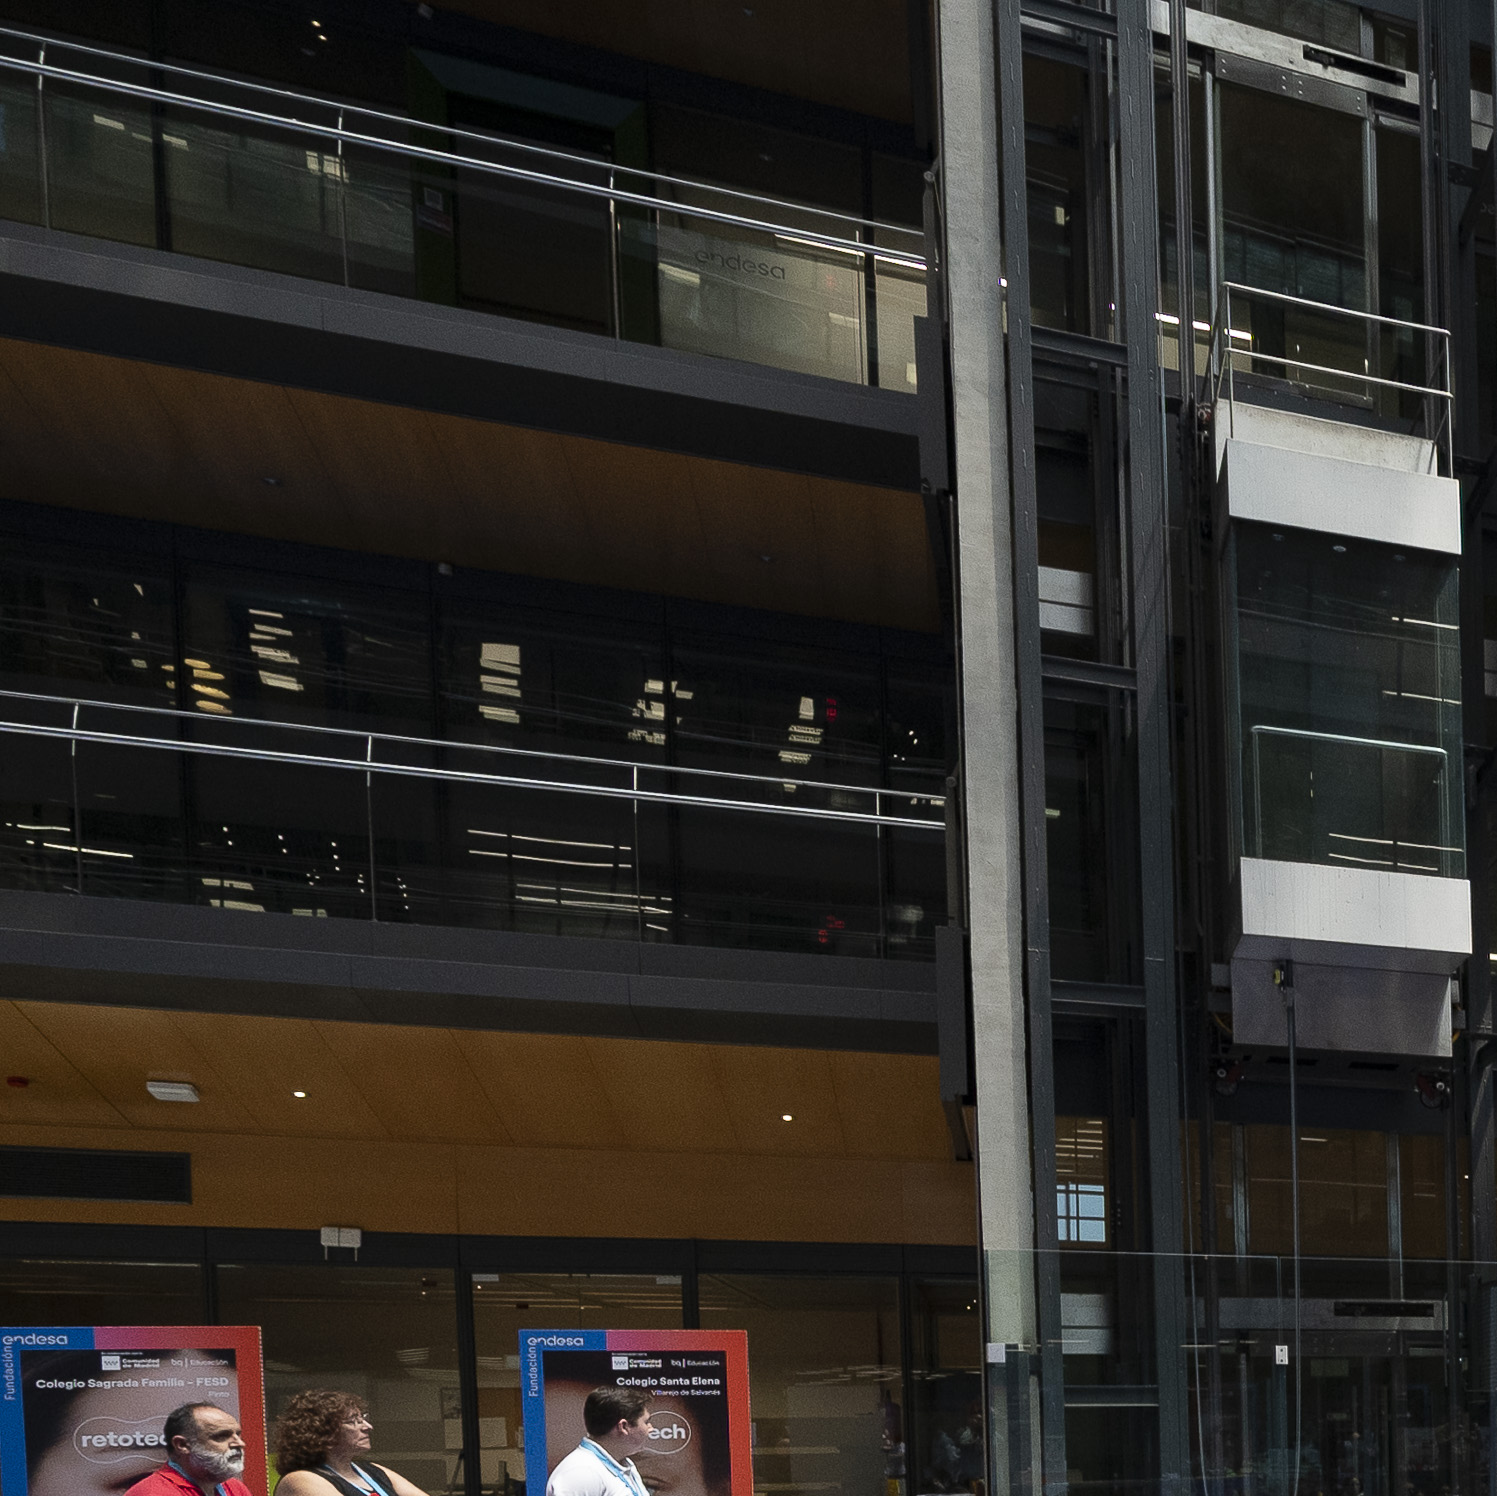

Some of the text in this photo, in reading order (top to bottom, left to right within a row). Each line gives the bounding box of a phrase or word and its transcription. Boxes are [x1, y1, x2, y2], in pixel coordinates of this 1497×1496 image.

[695, 250, 786, 281] endesa
[3, 1333, 68, 1346] endesa
[527, 1337, 584, 1347] endesa
[4, 1344, 15, 1401] Fundación
[528, 1344, 538, 1398] Fundación
[36, 1379, 85, 1391] Colegio
[87, 1379, 139, 1390] Sagrada
[141, 1377, 185, 1388] Familia
[196, 1377, 229, 1387] FESD
[616, 1377, 720, 1388] Colegio Santa Elena
[81, 1431, 167, 1448] retotec
